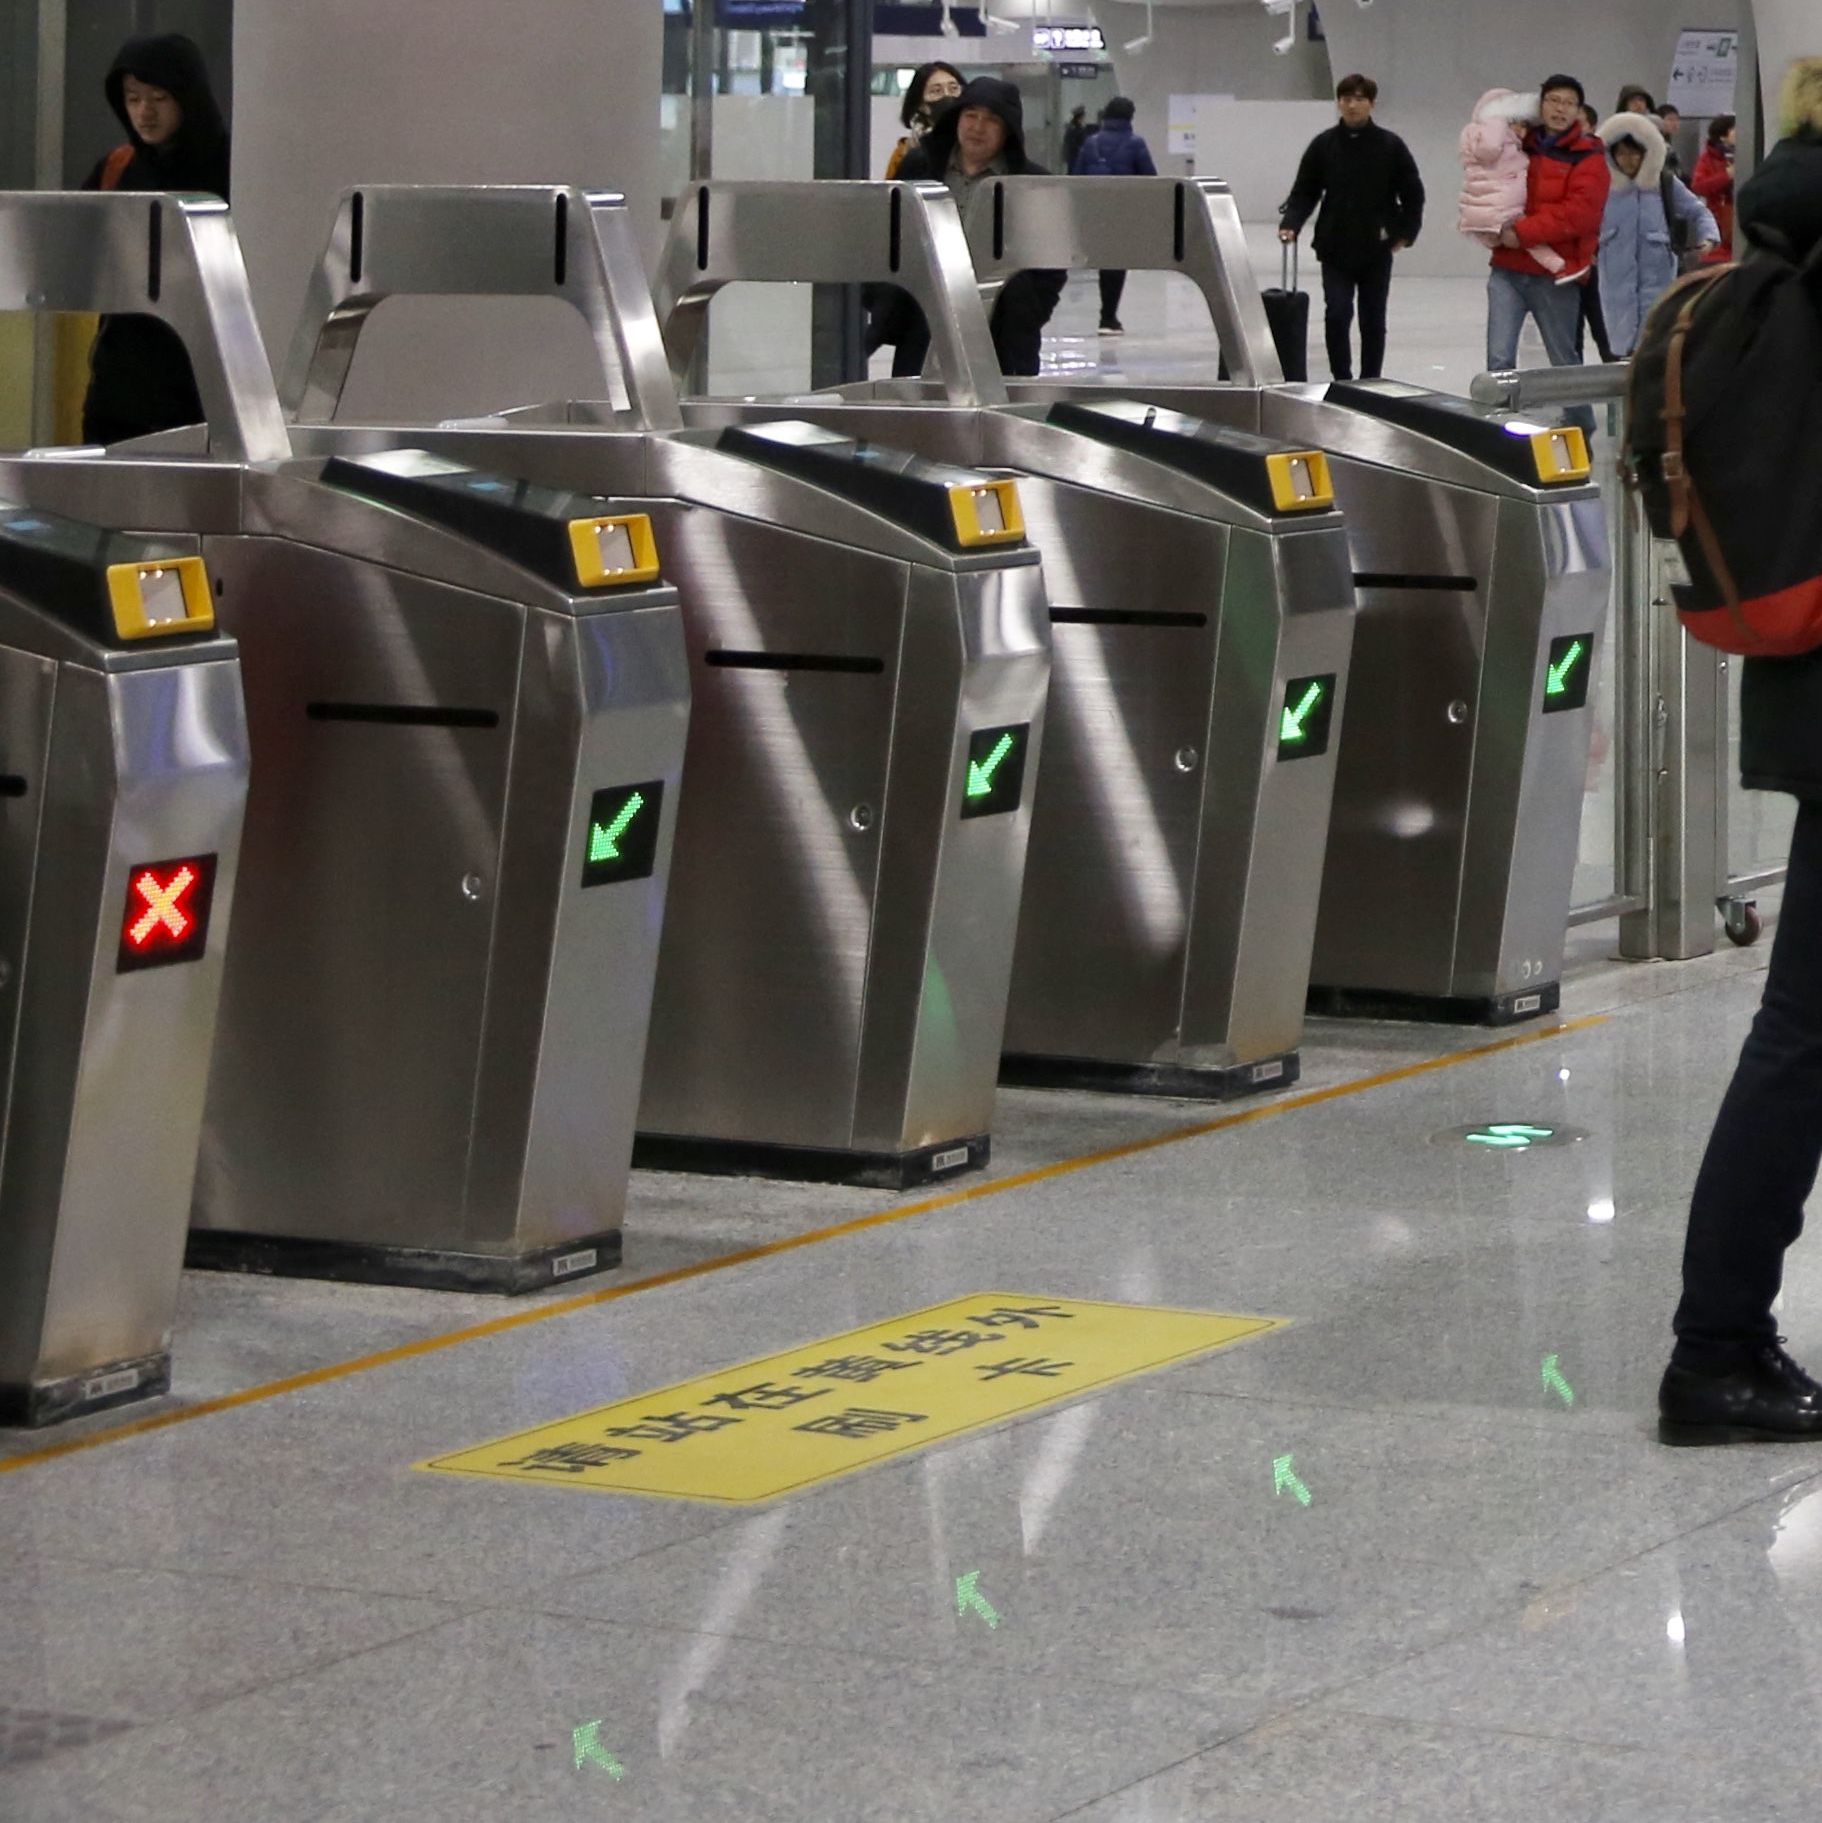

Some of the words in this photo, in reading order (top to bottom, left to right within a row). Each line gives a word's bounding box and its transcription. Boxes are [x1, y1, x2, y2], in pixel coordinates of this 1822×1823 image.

[497, 1305, 1074, 1473] 请站在黄线外
